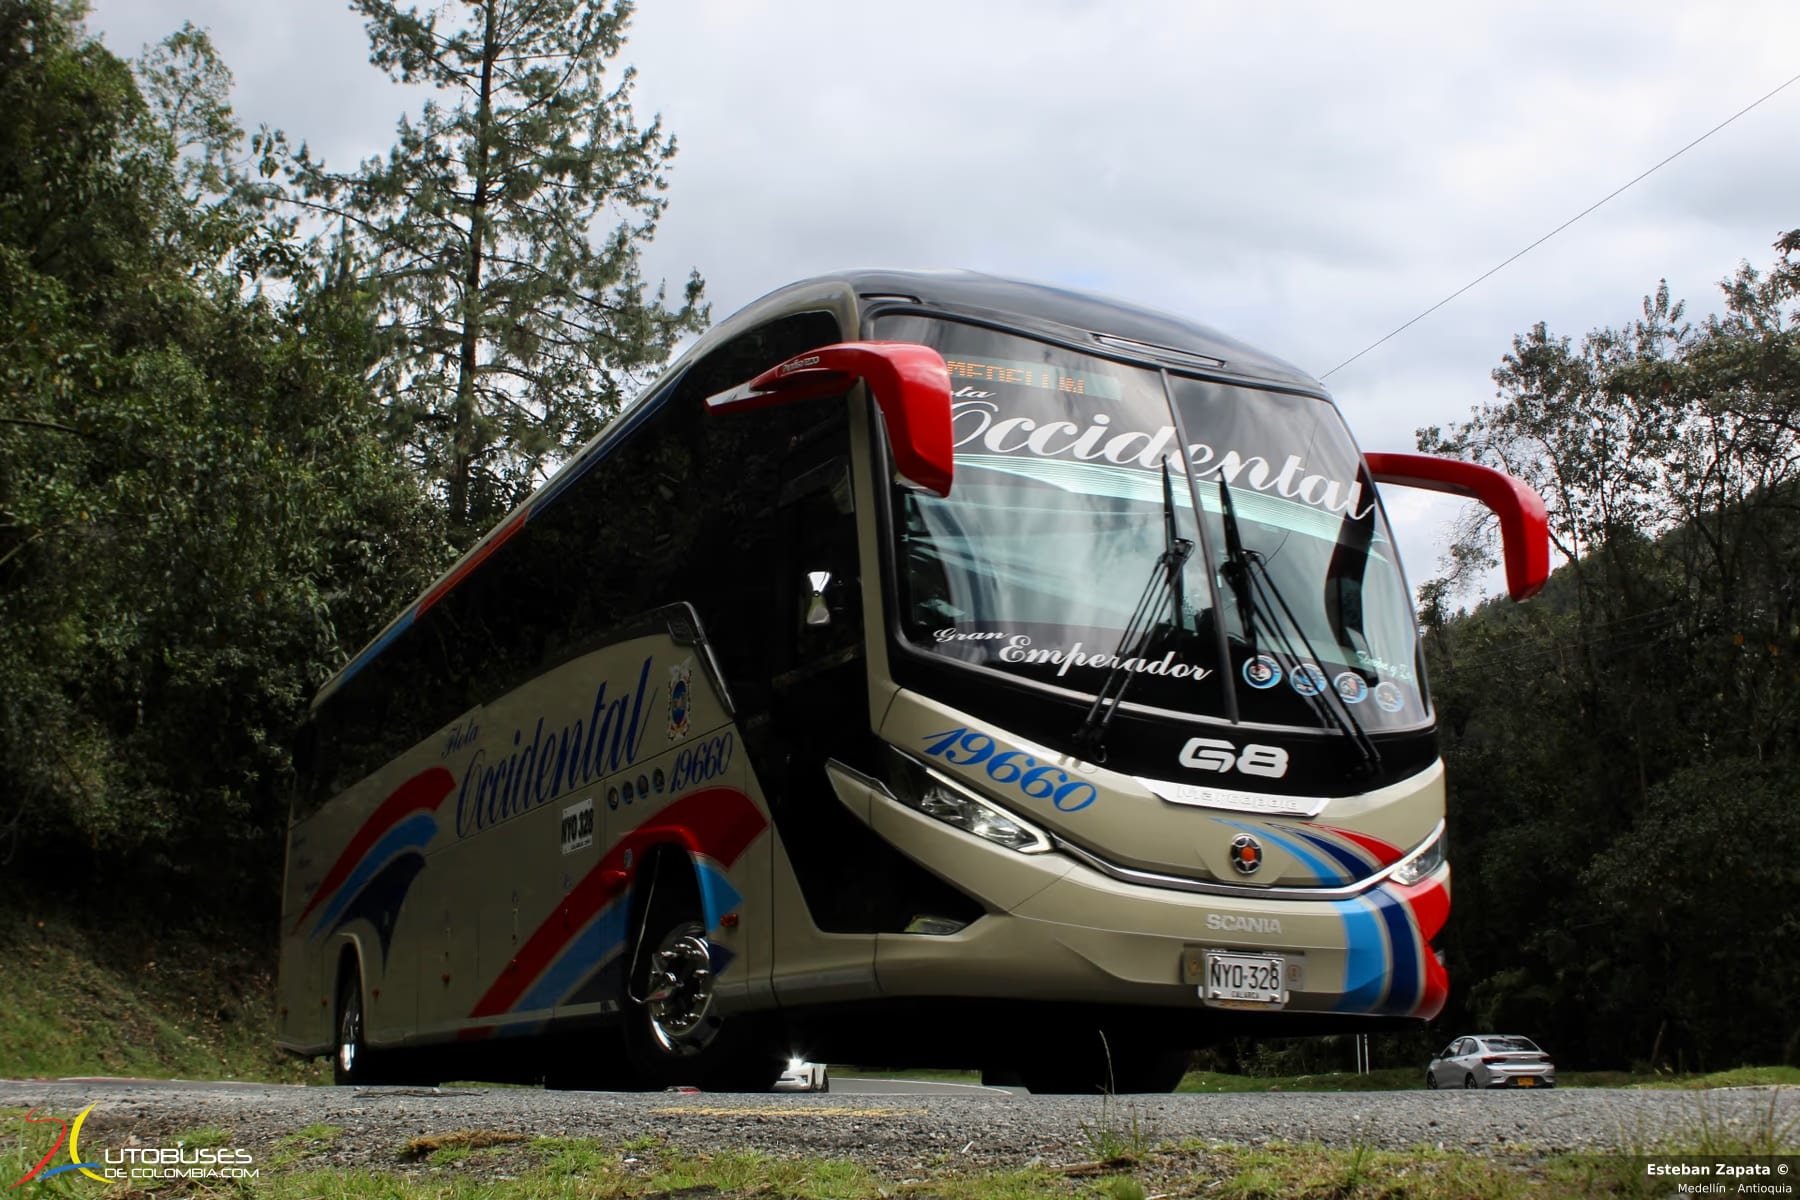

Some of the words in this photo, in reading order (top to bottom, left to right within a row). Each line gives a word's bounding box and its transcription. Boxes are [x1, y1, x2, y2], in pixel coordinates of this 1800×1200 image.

[933, 627, 1008, 642] Gran
[999, 634, 1212, 681] Emperador
[456, 656, 658, 838] Occidental
[669, 731, 733, 794] 19660
[922, 727, 1097, 813] 19660
[1178, 737, 1289, 778] G8
[1205, 914, 1281, 934] SCANIA
